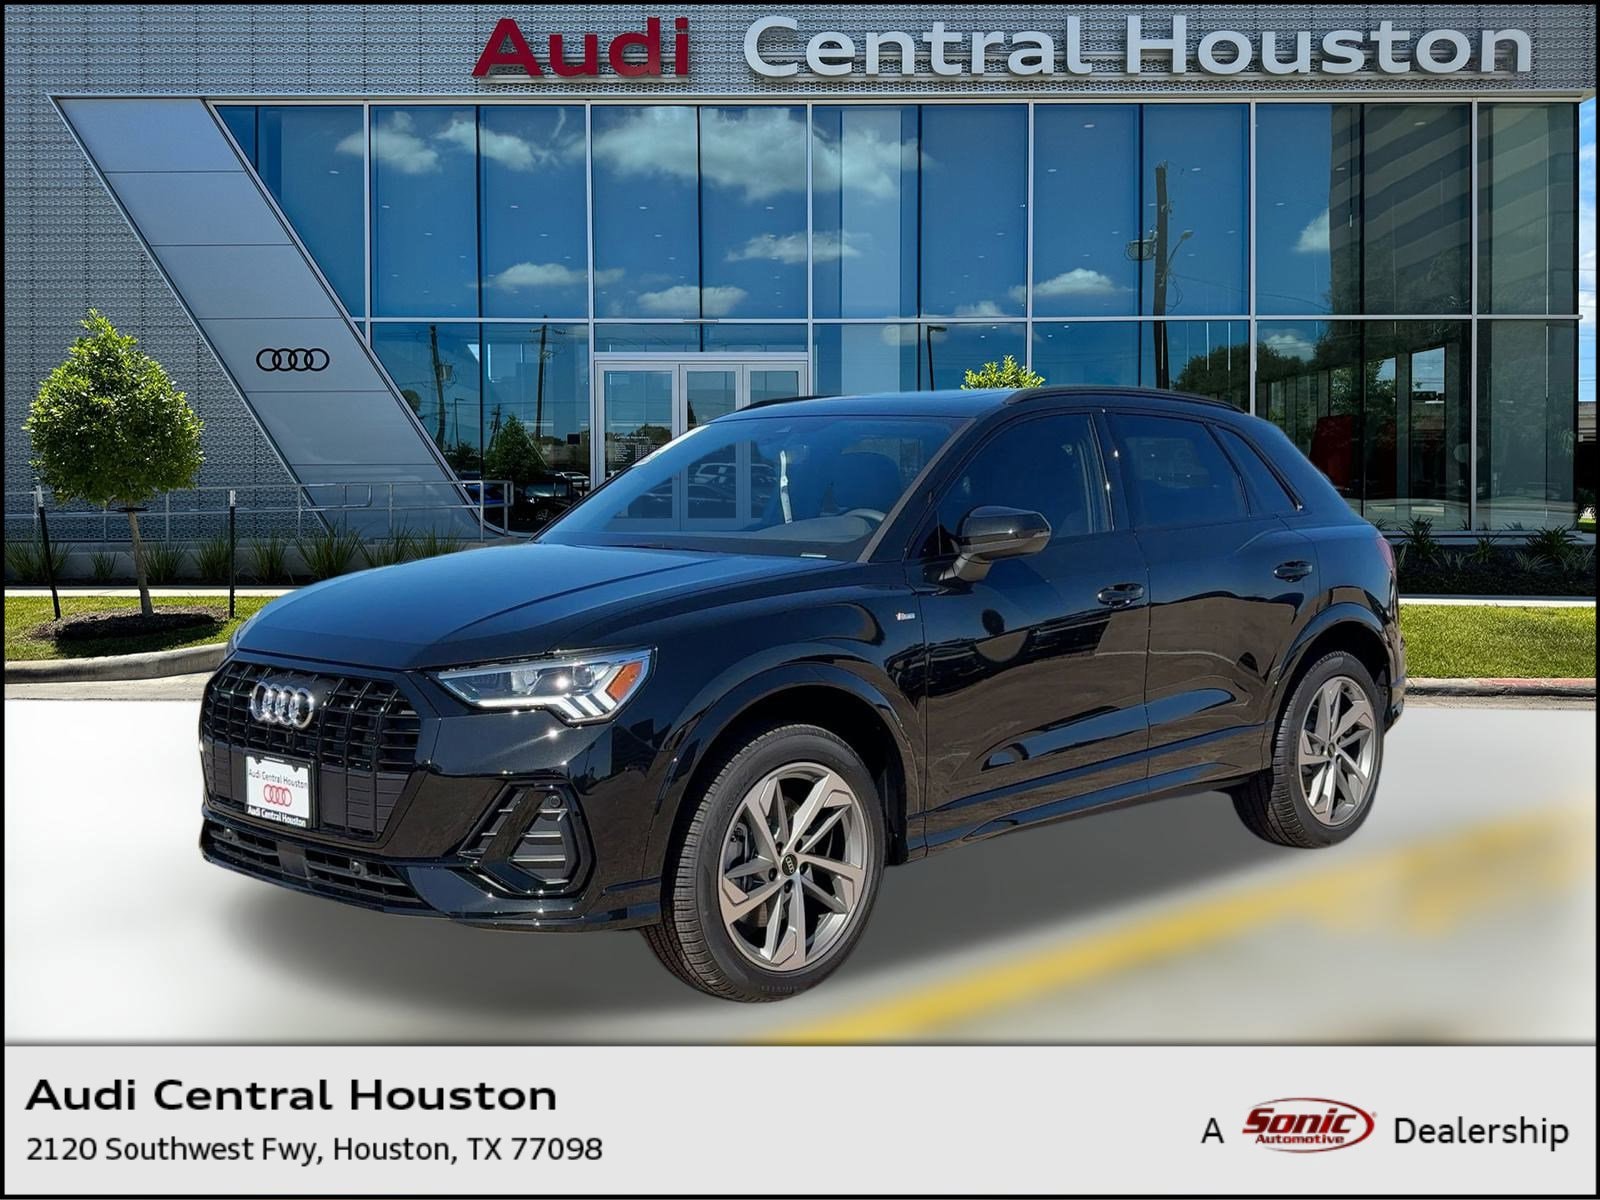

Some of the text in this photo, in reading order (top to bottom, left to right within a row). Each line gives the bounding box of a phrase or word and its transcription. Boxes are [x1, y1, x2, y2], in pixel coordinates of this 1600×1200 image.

[472, 15, 1532, 77] Audi Central Houston
[249, 768, 307, 788] Audi Central Houston
[248, 805, 306, 828] Audi Central Houston
